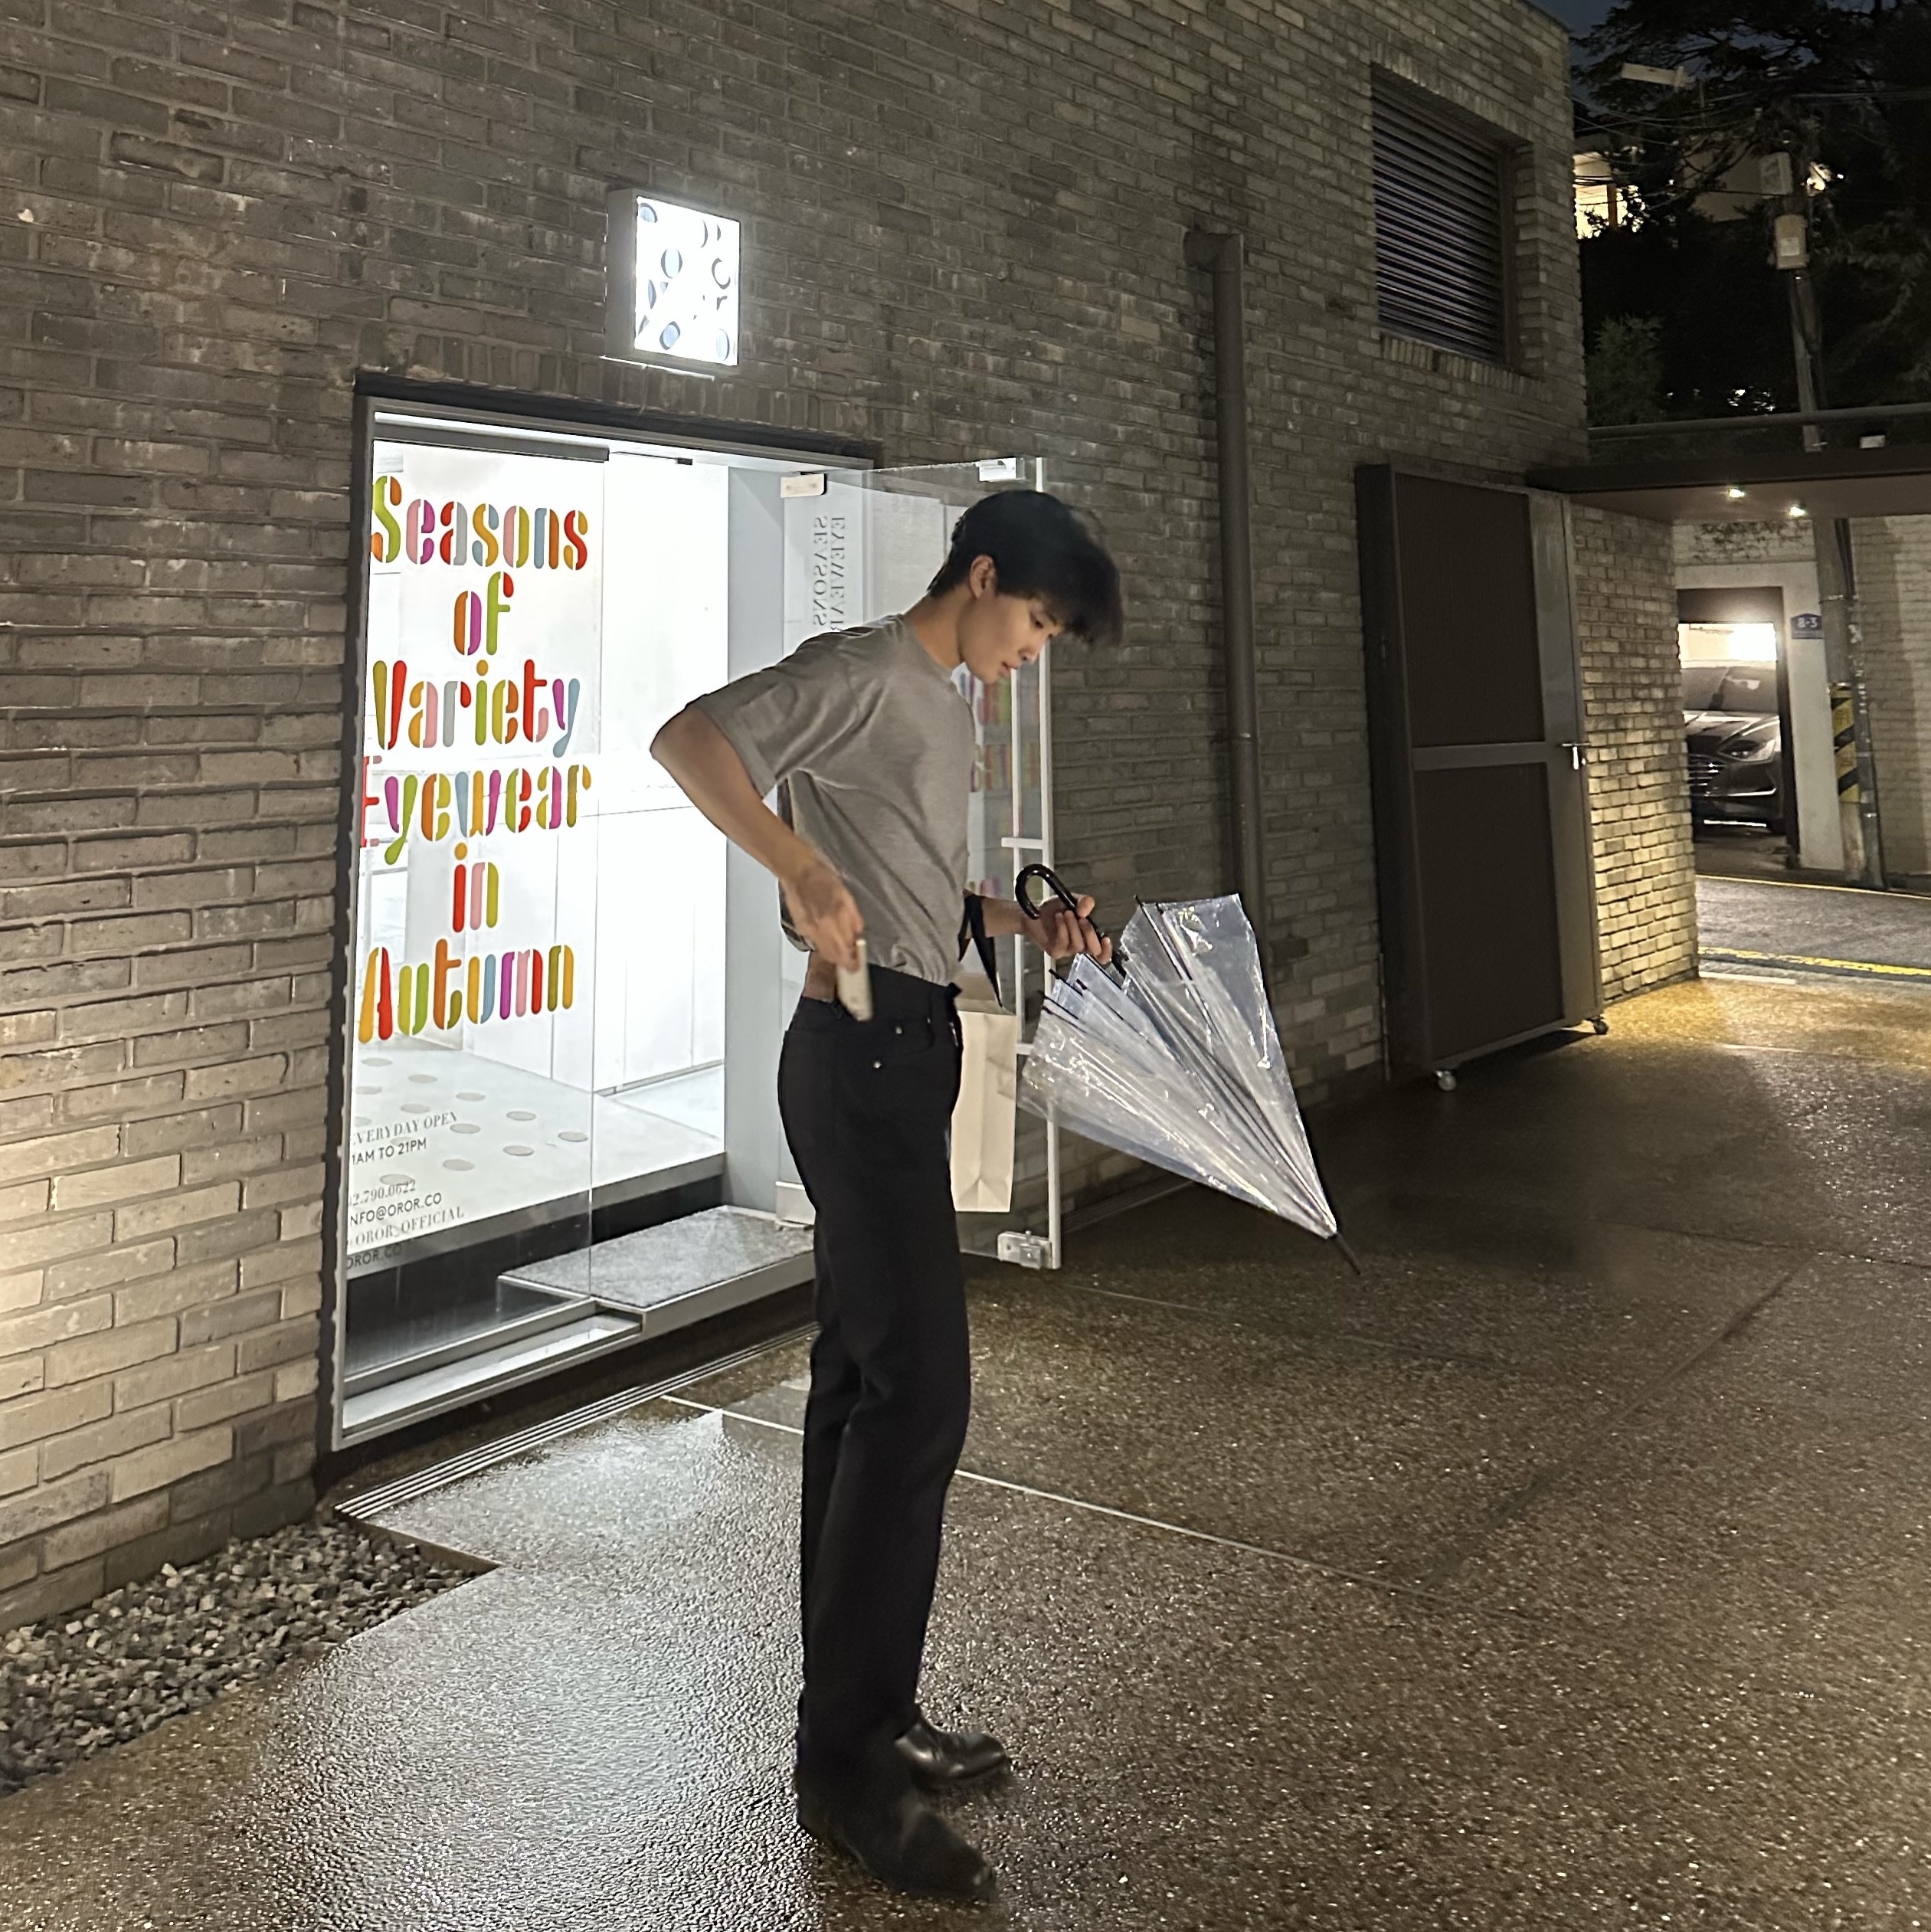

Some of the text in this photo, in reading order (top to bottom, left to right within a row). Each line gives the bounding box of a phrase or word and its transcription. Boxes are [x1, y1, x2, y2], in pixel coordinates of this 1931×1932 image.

[371, 475, 587, 570] Seasons
[453, 571, 514, 656] of
[372, 659, 580, 758] Variety
[453, 843, 499, 932] in
[358, 938, 574, 1043] Autumn
[378, 1145, 394, 1159] TO
[398, 1137, 427, 1155] 21PM
[424, 1111, 457, 1129] OPEN
[349, 1179, 416, 1207] 2.790.0622
[349, 1206, 465, 1246] OROR_OFFICIAL
